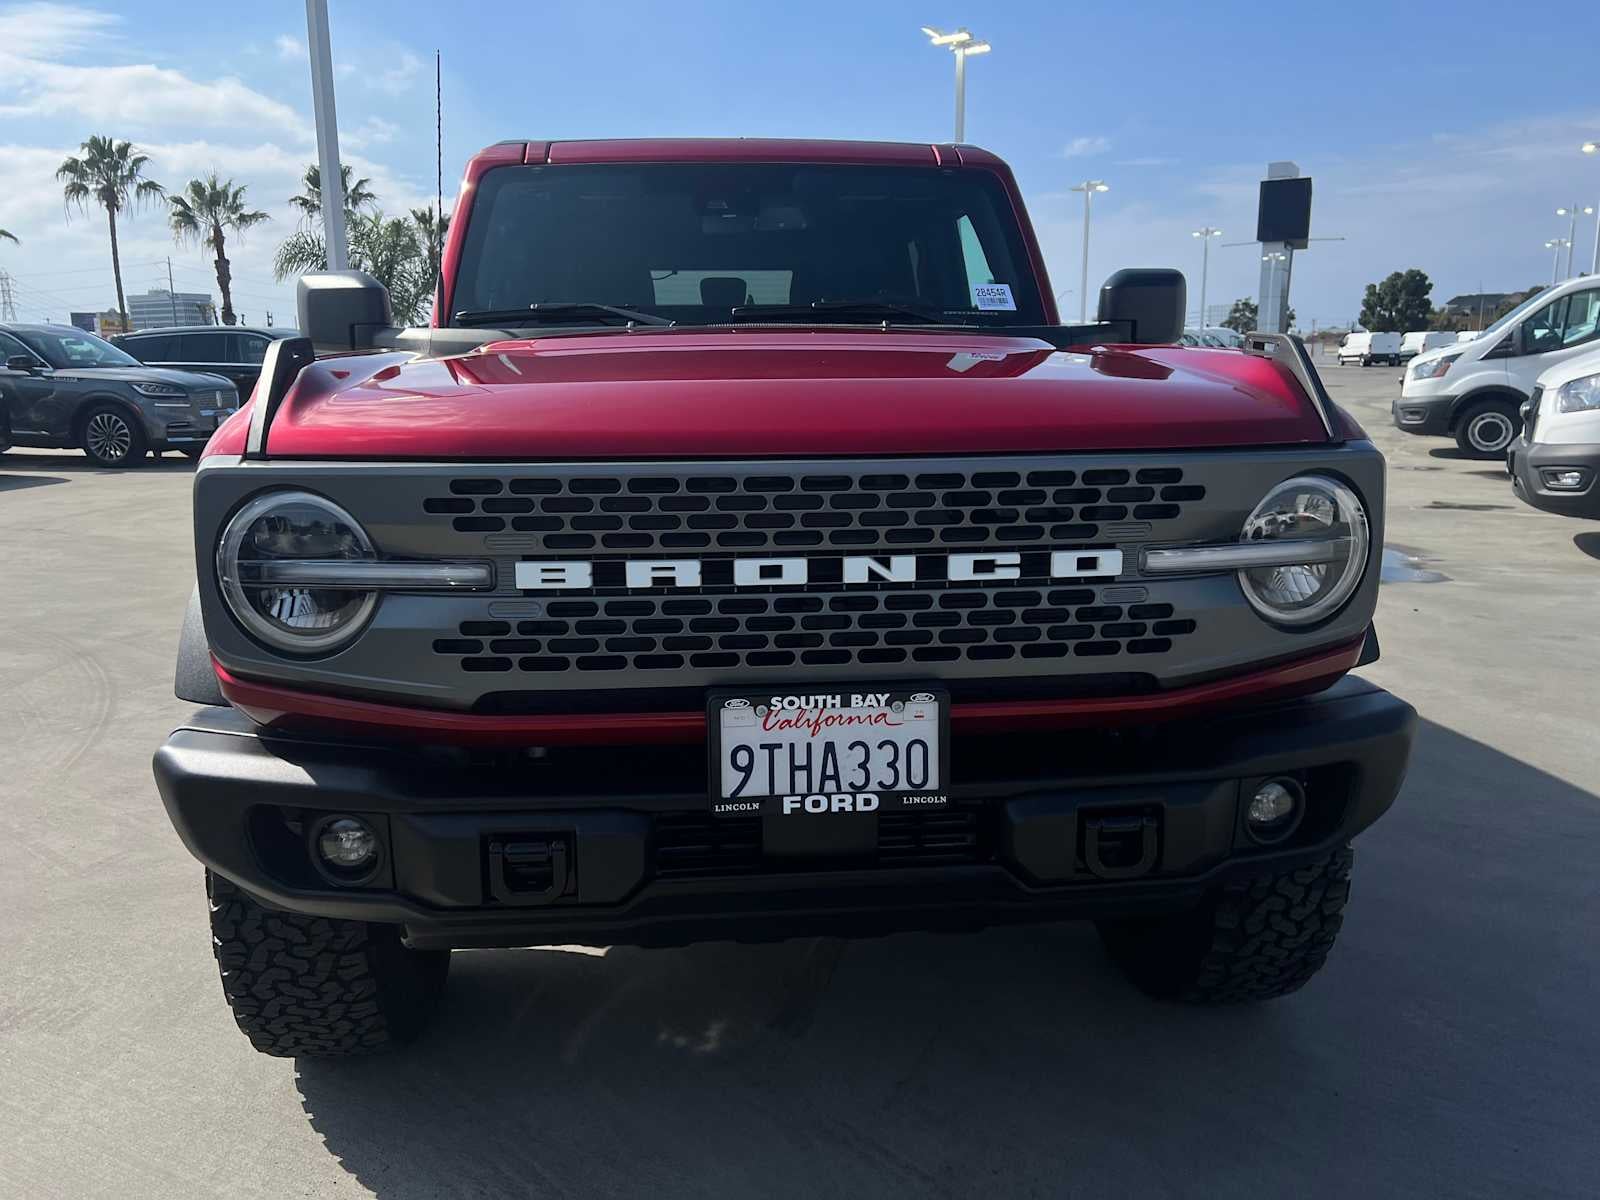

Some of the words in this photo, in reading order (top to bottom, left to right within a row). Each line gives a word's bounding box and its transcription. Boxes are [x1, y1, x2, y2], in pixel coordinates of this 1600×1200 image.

[515, 549, 1123, 589] BRONCO
[770, 695, 841, 711] SOUTH
[851, 693, 891, 708] BAY
[762, 708, 904, 737] California
[730, 739, 929, 798] 9THA330
[715, 803, 760, 812] LINCOLN
[783, 793, 880, 815] FORD
[903, 795, 947, 804] LINCOLN
